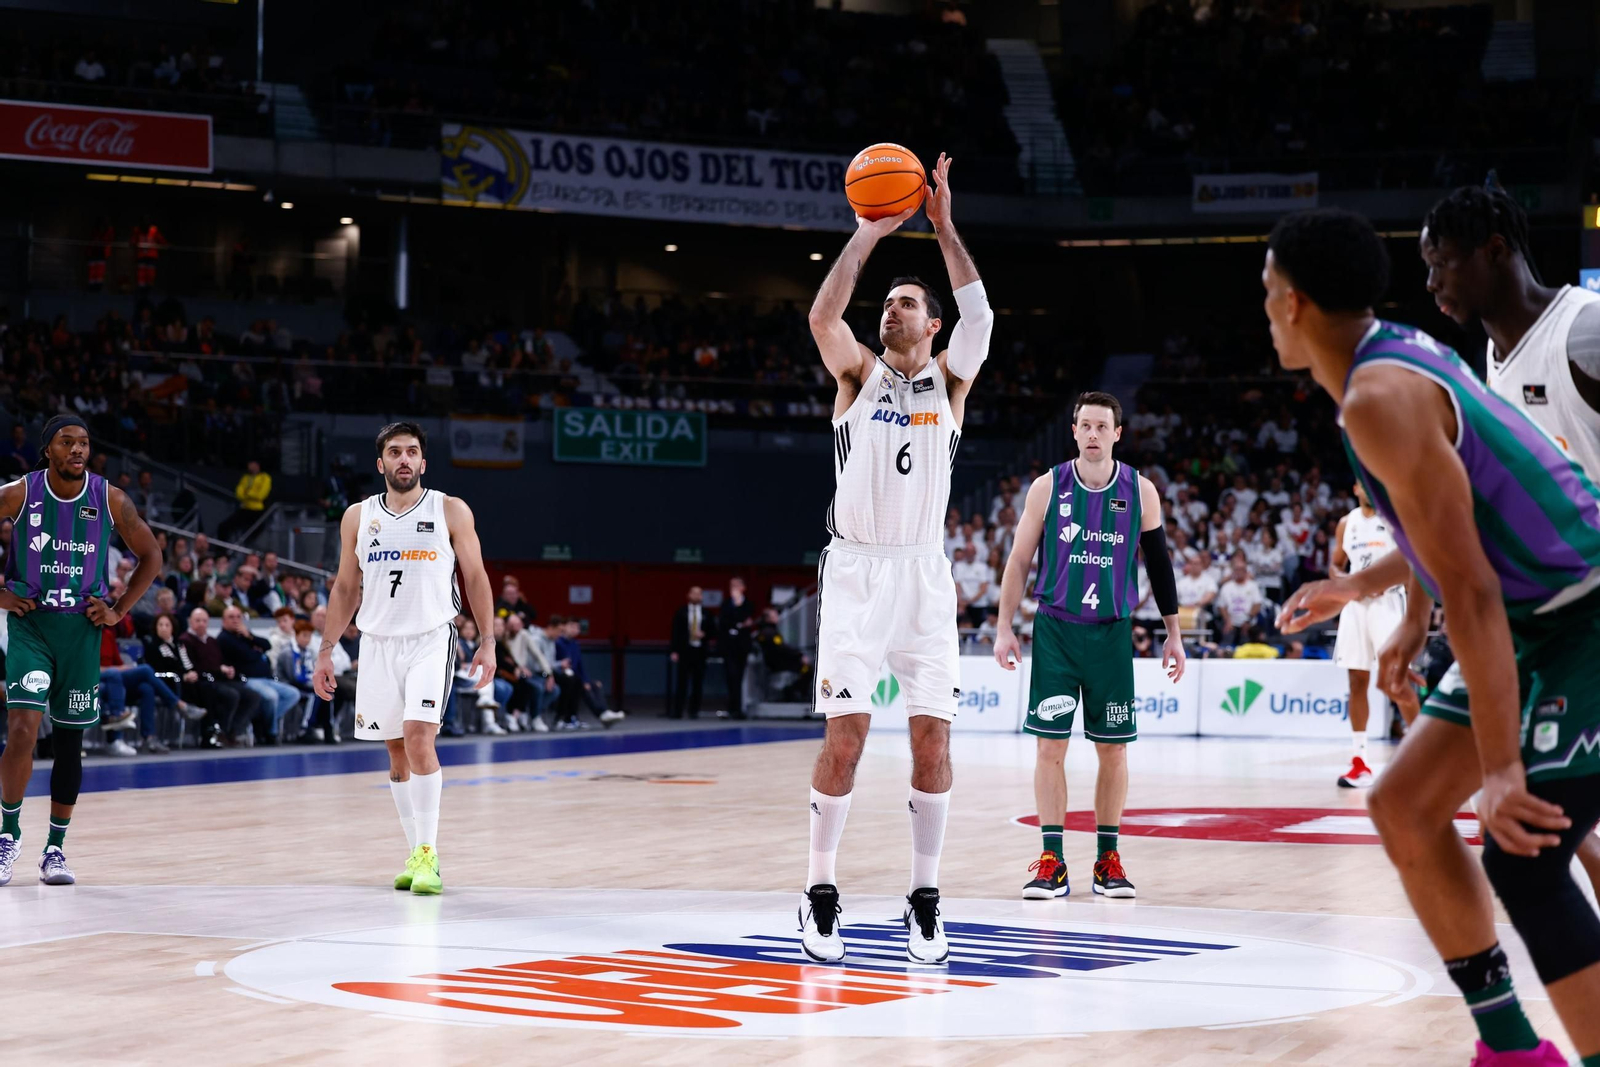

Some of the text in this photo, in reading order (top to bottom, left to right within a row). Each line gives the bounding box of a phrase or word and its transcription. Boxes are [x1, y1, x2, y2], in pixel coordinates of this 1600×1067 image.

[24, 113, 140, 156] Coca-Cola
[530, 138, 846, 193] LOS OJOS DEL TIGR
[531, 180, 619, 209] EUROPA
[624, 189, 653, 211] ES
[656, 192, 779, 218] TERRITORIO
[563, 410, 695, 442] SALIDA
[600, 440, 658, 462] EXIT
[896, 441, 912, 475] 6
[52, 539, 95, 556] Unicaja
[1082, 529, 1124, 546] Unicaja
[367, 550, 438, 563] AUTOHERO
[1069, 550, 1113, 568] málaga
[40, 560, 83, 578] málaga
[389, 570, 403, 598] 7
[41, 588, 76, 608] 55
[1081, 582, 1100, 610] 4
[68, 698, 91, 712] laga
[1269, 693, 1350, 720] Unicaj
[1106, 711, 1129, 724] laga
